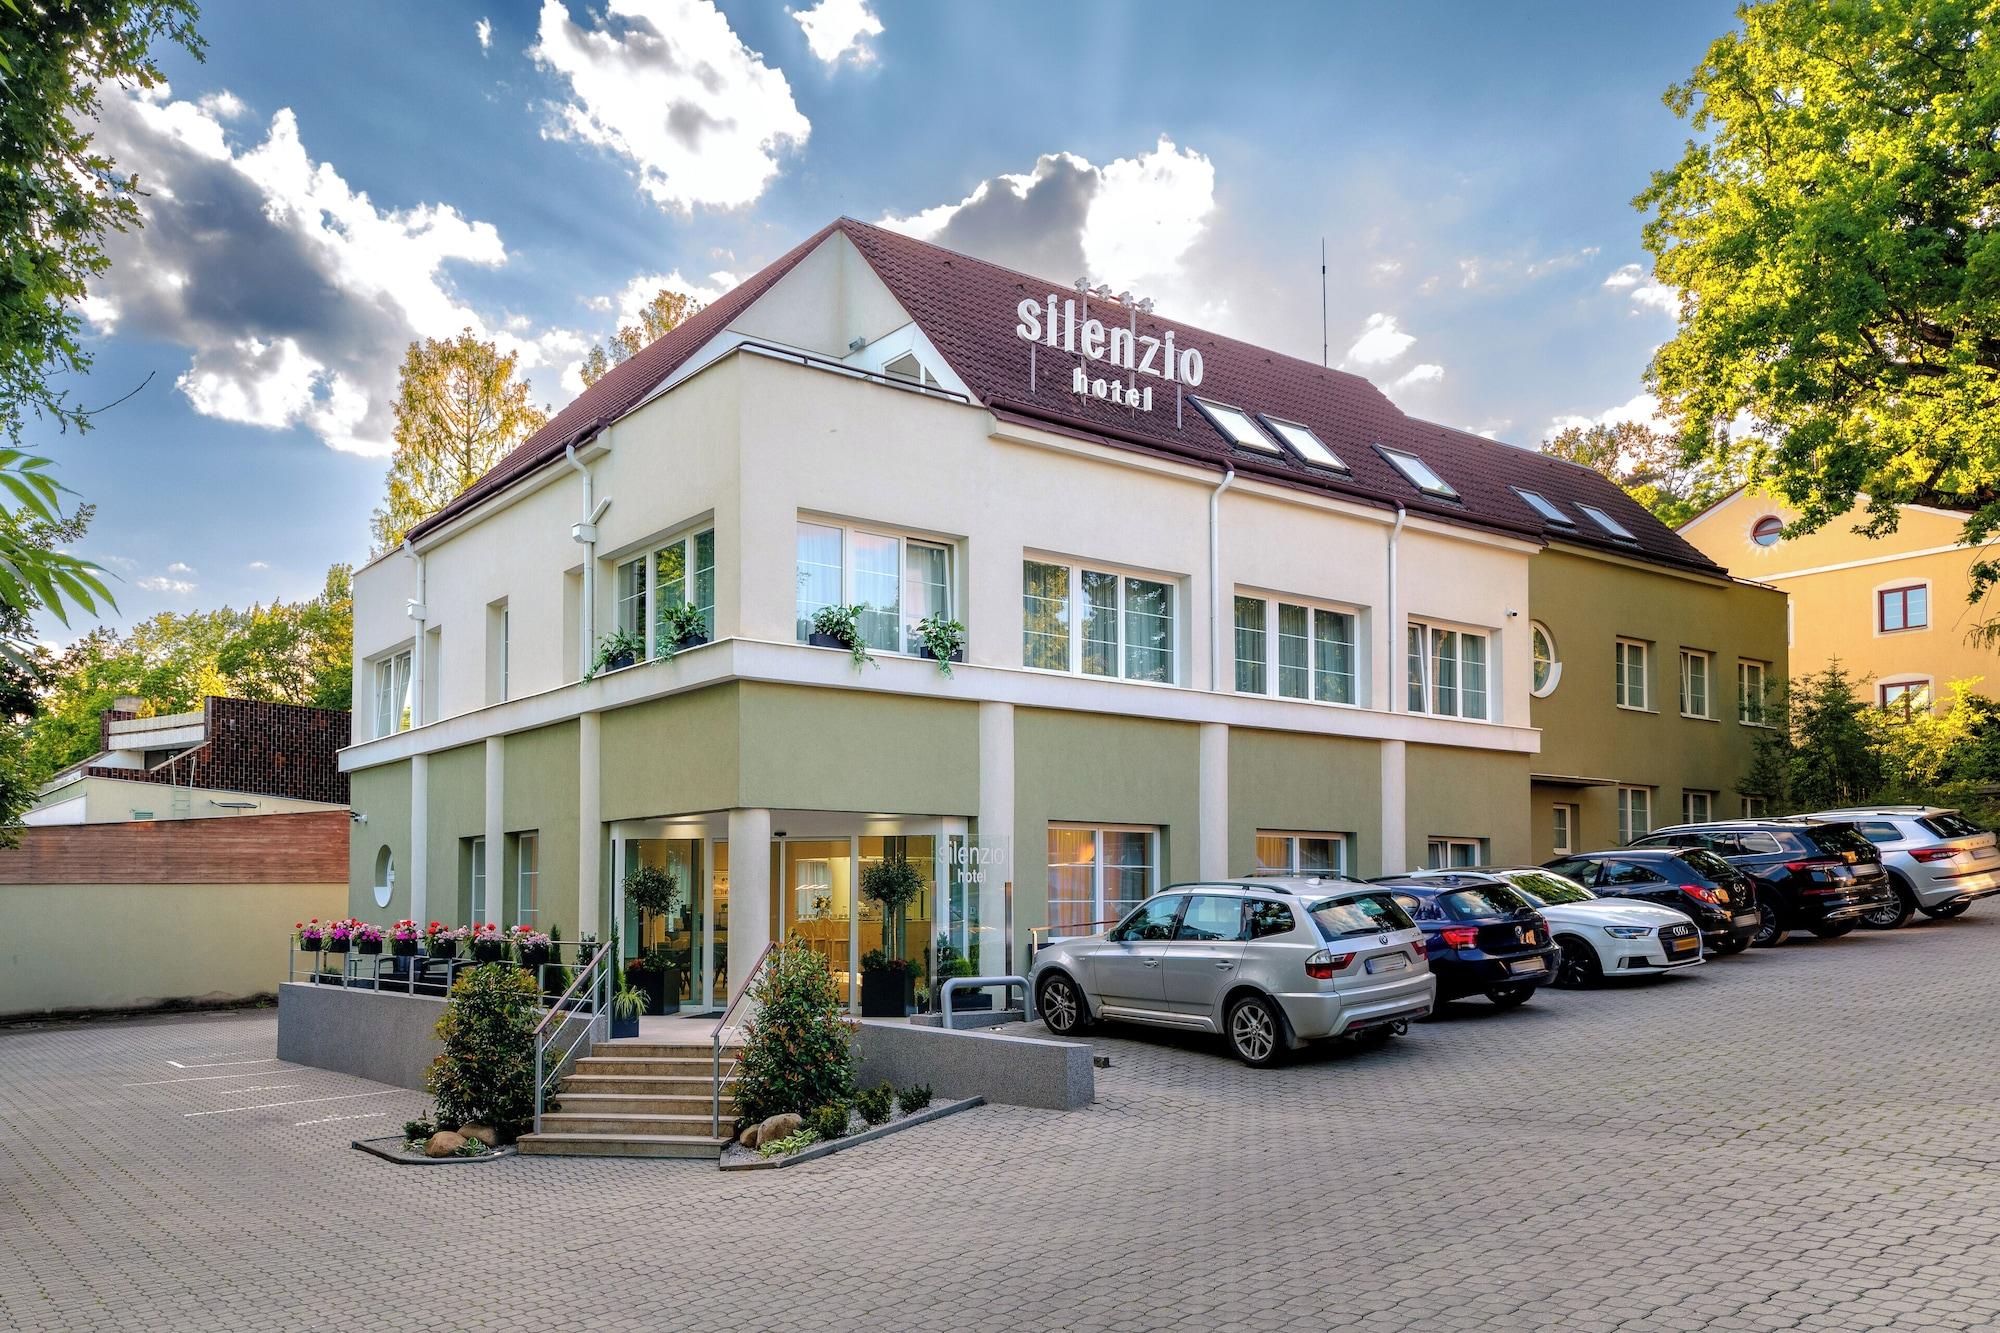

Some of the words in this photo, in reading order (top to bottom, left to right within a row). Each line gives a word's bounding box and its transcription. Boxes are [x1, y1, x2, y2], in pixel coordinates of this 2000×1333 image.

[1016, 294, 1204, 387] silenzio
[1072, 367, 1153, 412] hotel
[938, 840, 1006, 865] silenzio
[957, 868, 986, 883] hotel
